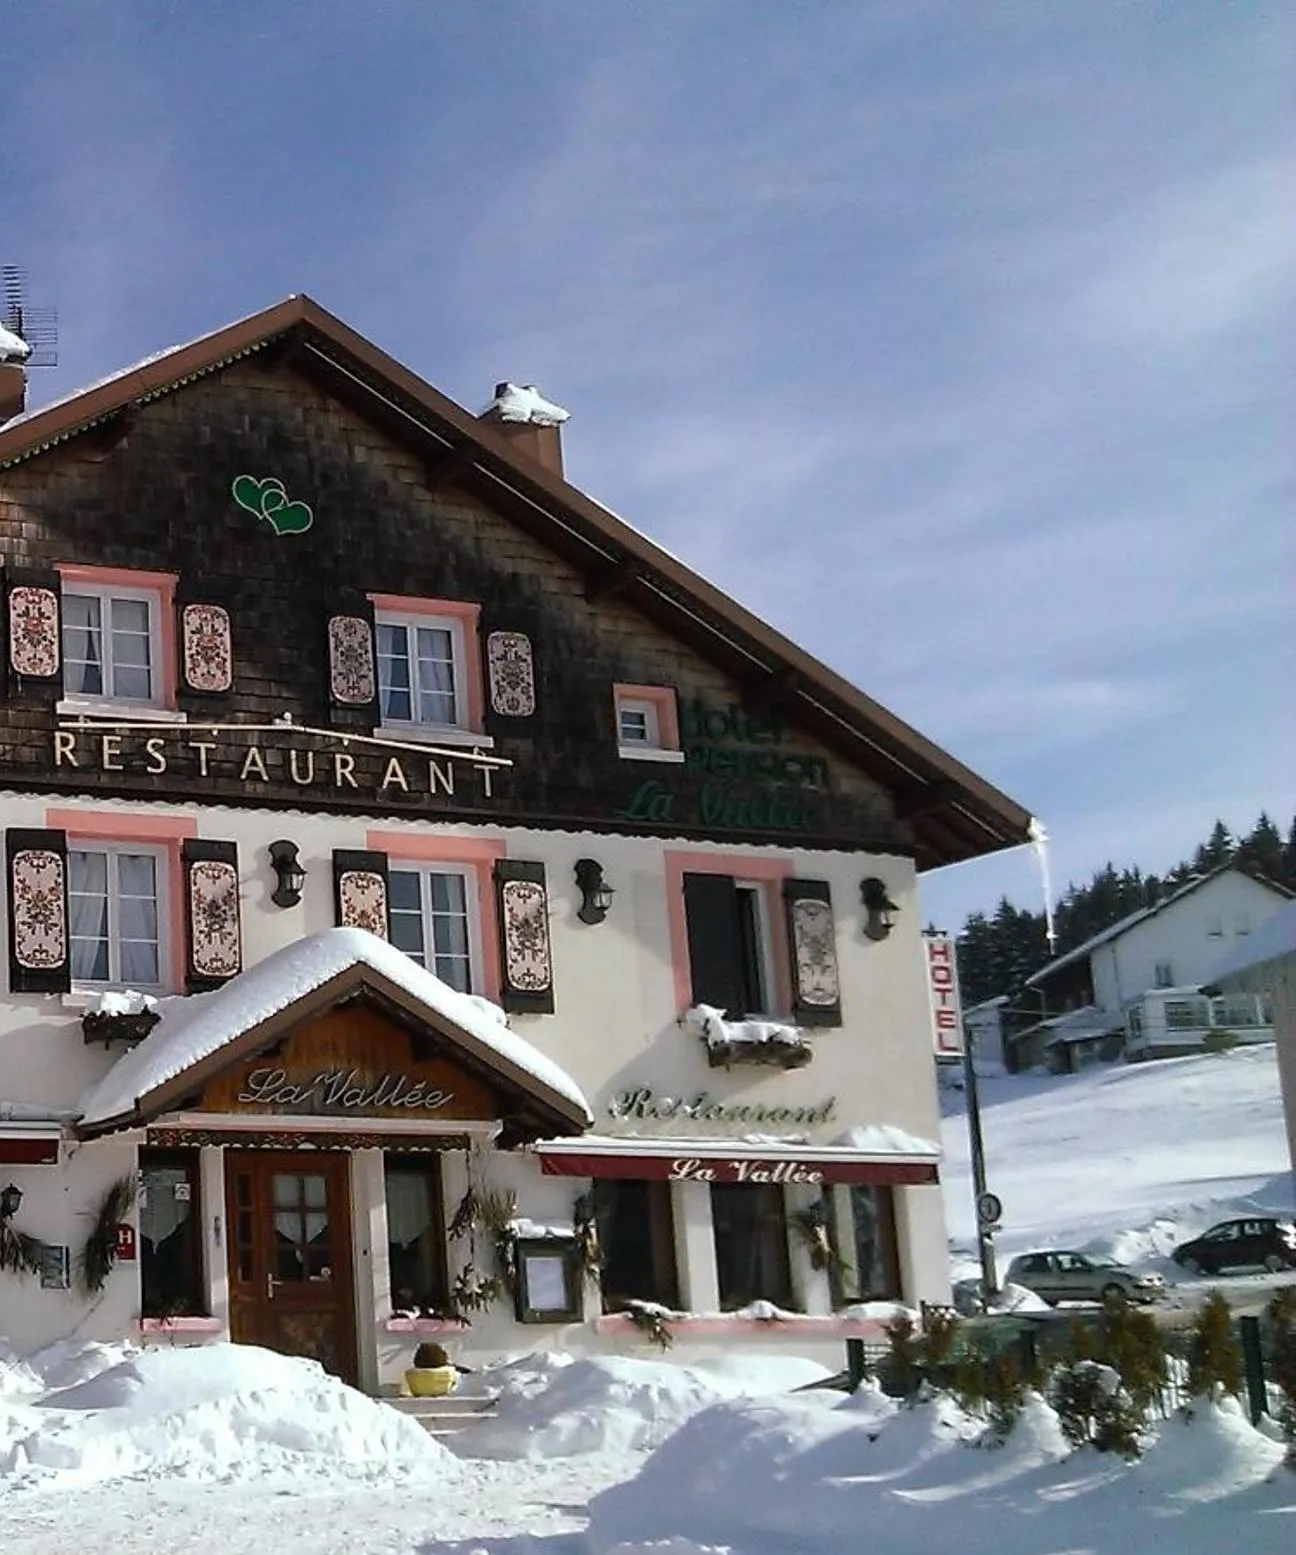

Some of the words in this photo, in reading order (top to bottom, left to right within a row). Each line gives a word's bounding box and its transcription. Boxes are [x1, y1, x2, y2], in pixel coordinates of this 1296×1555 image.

[54, 731, 499, 797] RESTAURANT
[929, 943, 960, 1052] HOTEL
[238, 1067, 311, 1104] La
[315, 1066, 453, 1109] Vallée
[668, 1158, 716, 1181] La
[729, 1160, 824, 1183] Vallée
